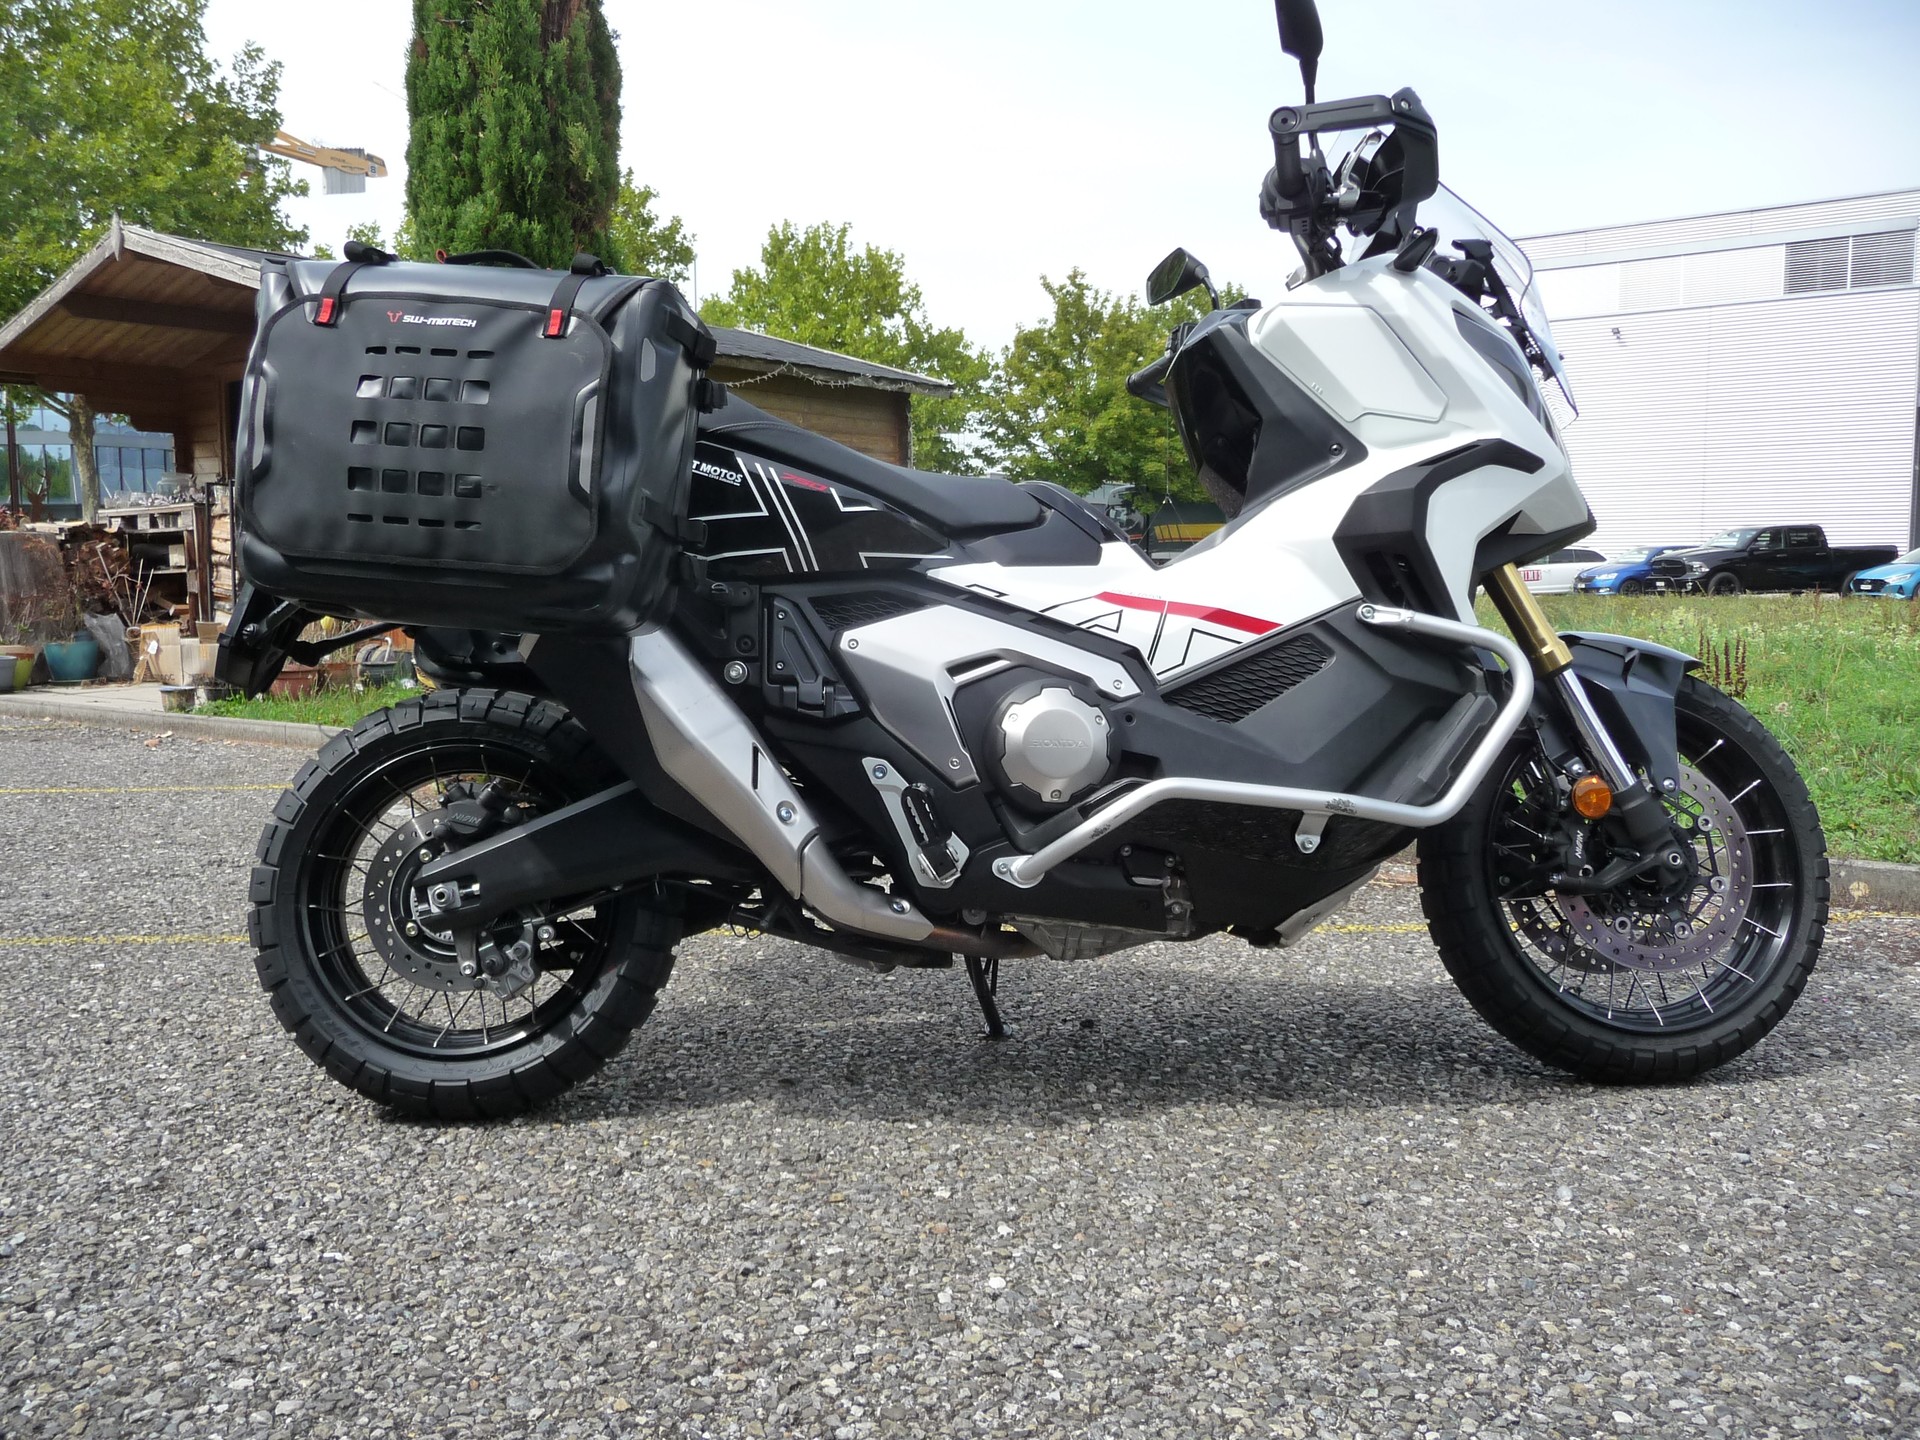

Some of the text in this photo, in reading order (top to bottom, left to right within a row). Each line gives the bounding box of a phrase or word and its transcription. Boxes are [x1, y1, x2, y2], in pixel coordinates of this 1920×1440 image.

[402, 314, 477, 328] SW-MOTECH
[699, 462, 743, 483] MOTOS
[1028, 738, 1089, 749] HONDA
